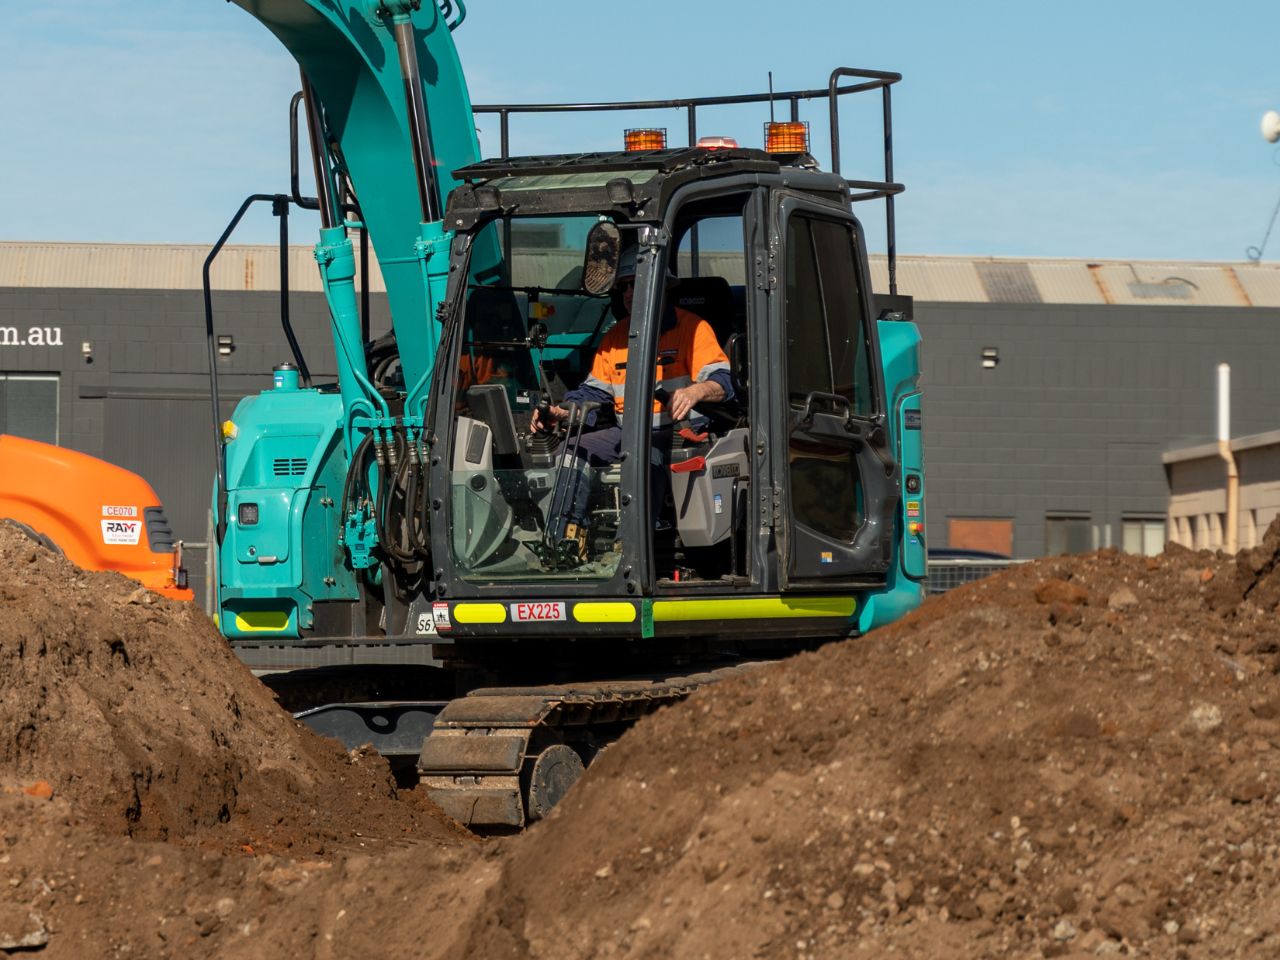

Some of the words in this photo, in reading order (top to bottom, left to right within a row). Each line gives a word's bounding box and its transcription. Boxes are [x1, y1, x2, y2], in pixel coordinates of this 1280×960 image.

[107, 506, 133, 516] CE070
[106, 522, 137, 533] RAM
[517, 603, 561, 621] EX225
